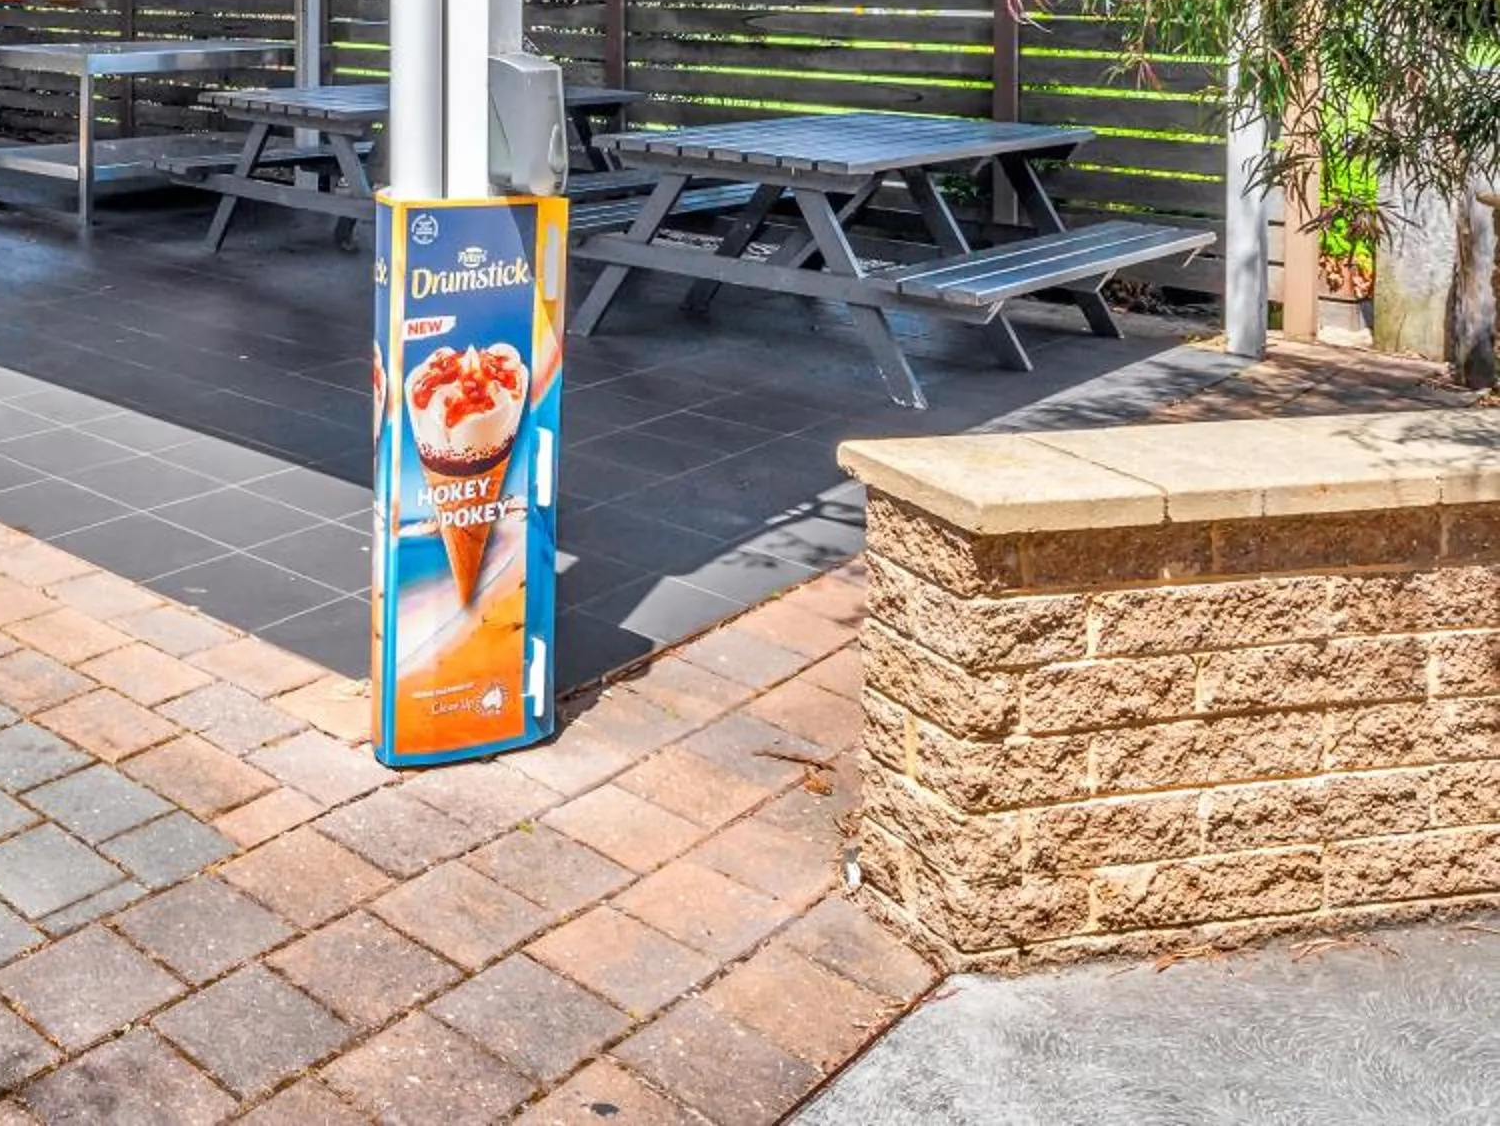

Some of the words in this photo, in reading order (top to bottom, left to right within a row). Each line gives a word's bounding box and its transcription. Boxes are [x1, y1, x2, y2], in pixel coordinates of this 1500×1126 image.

[411, 257, 530, 299] Drumstick
[407, 320, 443, 335] NEW
[417, 476, 491, 507] HOKEY
[439, 499, 510, 530] POKEY
